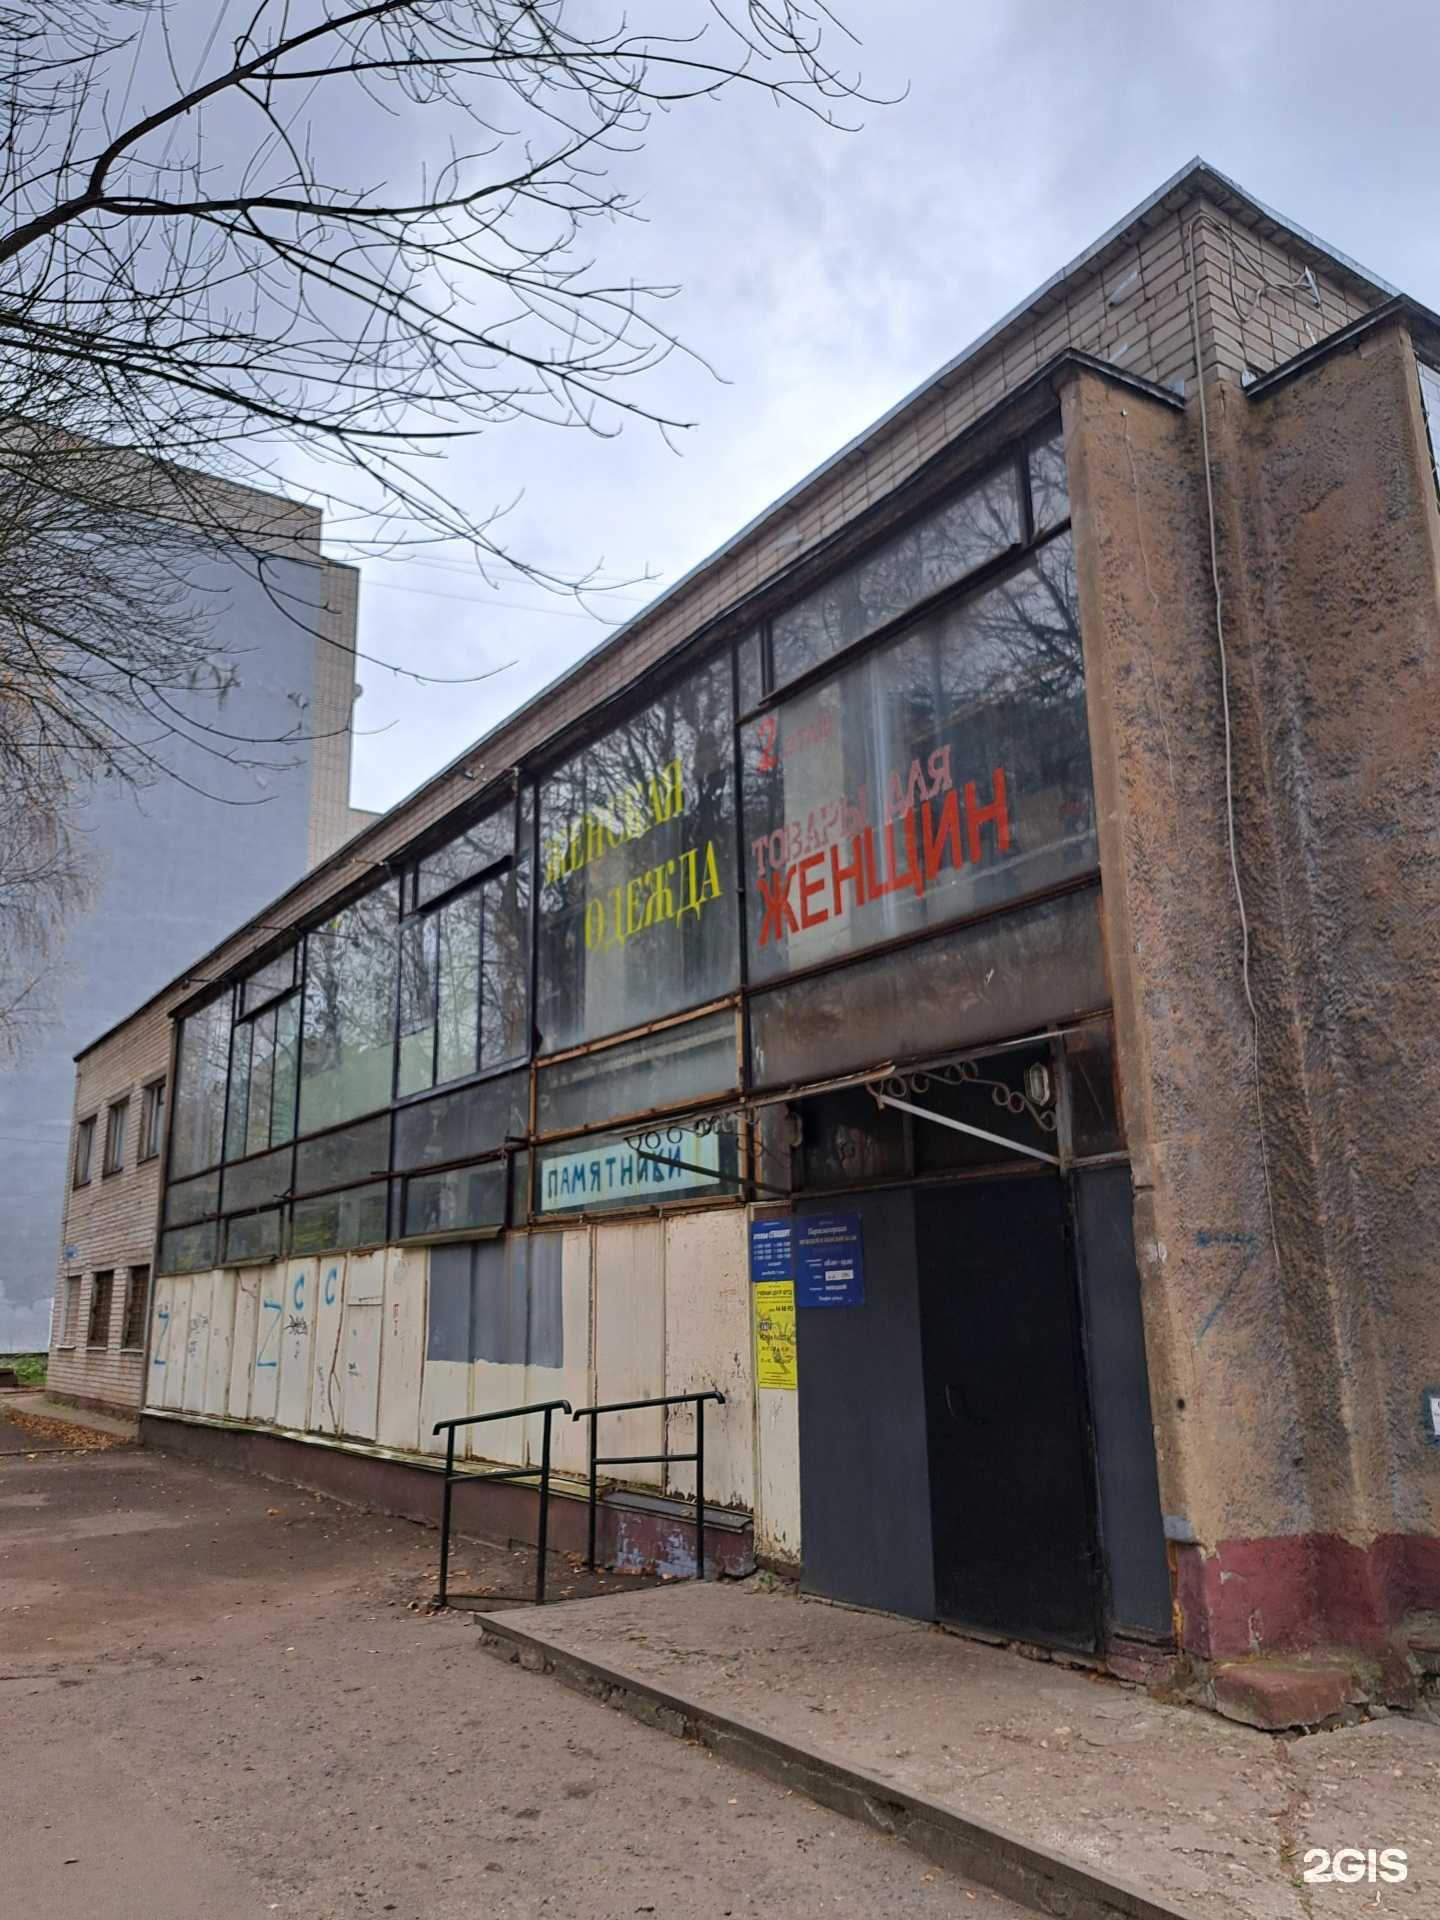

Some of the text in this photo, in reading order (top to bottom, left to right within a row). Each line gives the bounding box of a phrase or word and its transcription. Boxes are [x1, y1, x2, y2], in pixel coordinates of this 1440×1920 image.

[752, 744, 953, 877] ТОВАРЫ ДЛЯ
[757, 767, 1010, 946] ЖЕНЩИН
[585, 839, 722, 953] ОДЕЖДА
[547, 1145, 682, 1199] ПАМЯТНИКИ
